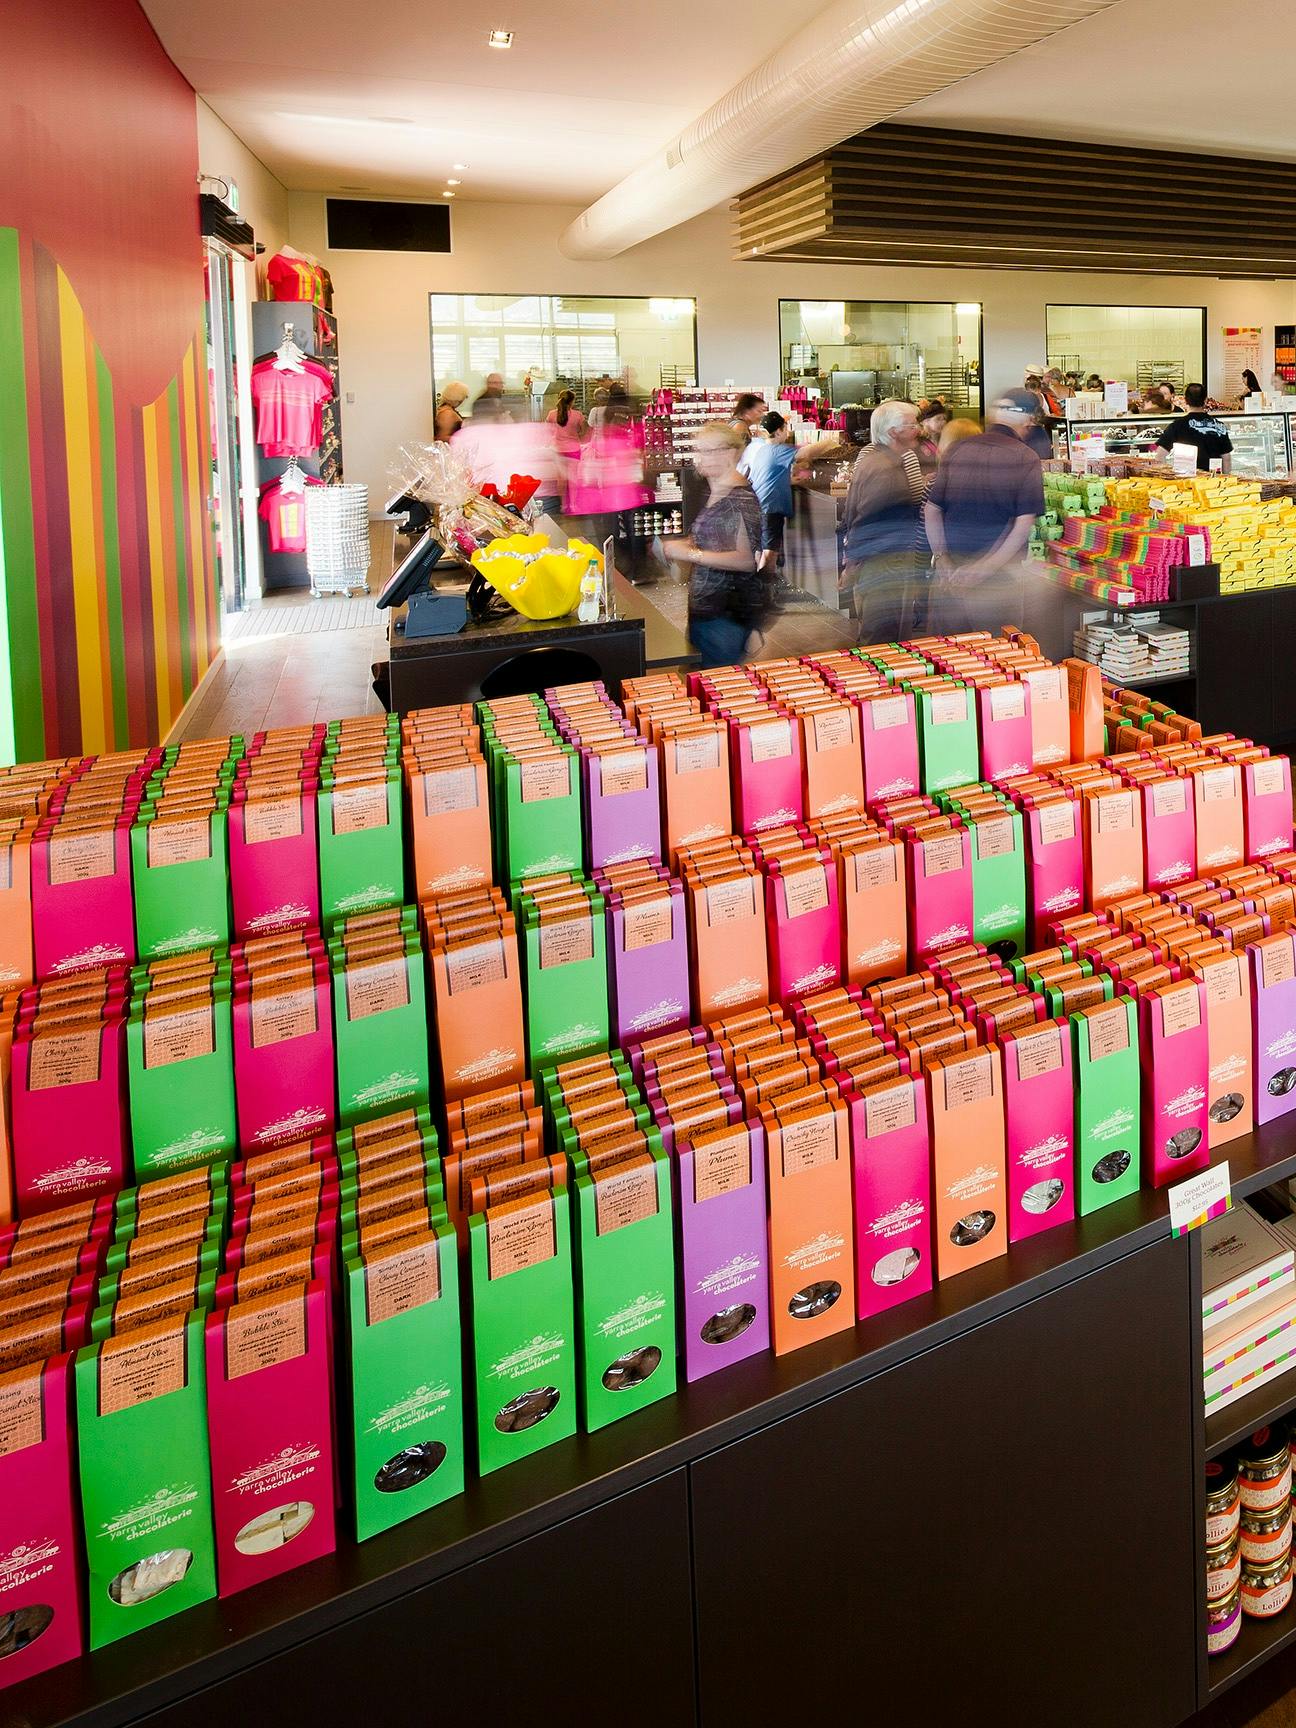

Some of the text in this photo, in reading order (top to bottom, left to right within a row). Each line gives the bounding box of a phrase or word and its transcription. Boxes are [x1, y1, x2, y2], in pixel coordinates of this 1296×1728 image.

[350, 902, 392, 915] chocolaterie
[262, 921, 307, 936] chocolaterie
[78, 962, 103, 971] valley
[644, 1017, 680, 1033] chocolaterie
[61, 1036, 87, 1044] Ultimate
[472, 1065, 513, 1084] chocolaterie
[358, 1095, 378, 1106] yarra
[370, 1090, 416, 1108] chocolaterie
[273, 1127, 322, 1147] chocolaterie
[282, 1128, 305, 1138] valley
[155, 1149, 202, 1168] yarra valley
[169, 1149, 221, 1169] chocolaterie
[709, 1153, 737, 1166] Plums
[39, 1177, 87, 1193] yarra valley
[52, 1179, 106, 1196] chocolaterie
[960, 1182, 995, 1200] chocolaterie
[968, 1183, 984, 1196] valley
[1192, 1181, 1223, 1200] Chocolates
[884, 1218, 922, 1238] chocolaterie
[891, 1221, 908, 1233] valley
[789, 1250, 827, 1270] yarra valley
[800, 1250, 842, 1271] chocolaterie
[32, 1268, 61, 1281] Ultimate
[247, 1281, 282, 1298] Bubble
[703, 1273, 742, 1296] yarra valley
[714, 1273, 757, 1296] chocolaterie
[119, 1290, 195, 1320] Scrummy Caramelised
[604, 1315, 646, 1339] yarra valley
[616, 1313, 662, 1339] chocolaterie
[104, 1332, 184, 1361] Scrummy Caramelised
[498, 1355, 543, 1379] yarra valley
[510, 1353, 561, 1379] chocolaterie
[134, 1381, 155, 1392] WHITE
[377, 1407, 427, 1434] yarra valley
[391, 1404, 446, 1434] chocolaterie
[239, 1467, 293, 1495] yarra valley
[254, 1466, 315, 1495] chocolaterie
[110, 1511, 169, 1541] yarra valley
[126, 1508, 192, 1541] chocolaterie
[1206, 1526, 1229, 1538] ollies
[0, 1569, 27, 1584] alley
[0, 1563, 54, 1593] ocolaterie
[1207, 1580, 1229, 1592] ollies
[1262, 1594, 1288, 1610] Lollies
